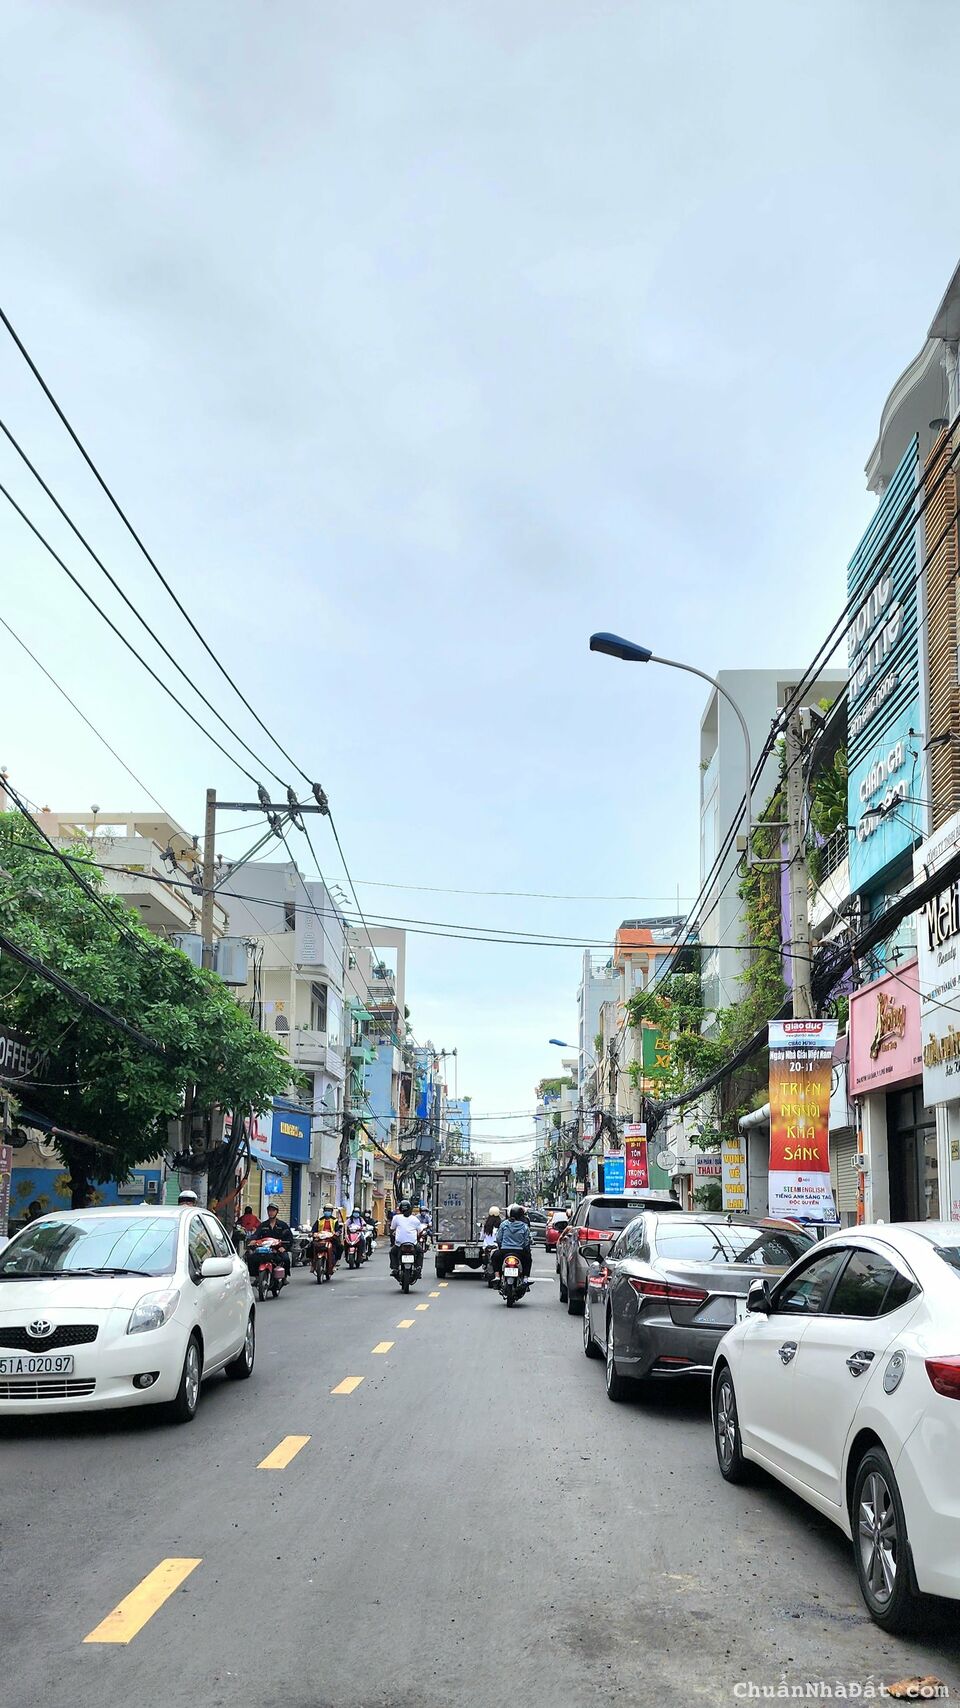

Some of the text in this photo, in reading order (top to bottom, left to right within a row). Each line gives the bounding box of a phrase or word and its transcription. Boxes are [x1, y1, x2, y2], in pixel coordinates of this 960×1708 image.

[770, 1051, 784, 1060] Ngày
[785, 1050, 796, 1059] Nhà
[808, 1050, 819, 1061] Việt
[790, 1062, 813, 1072] 20-11
